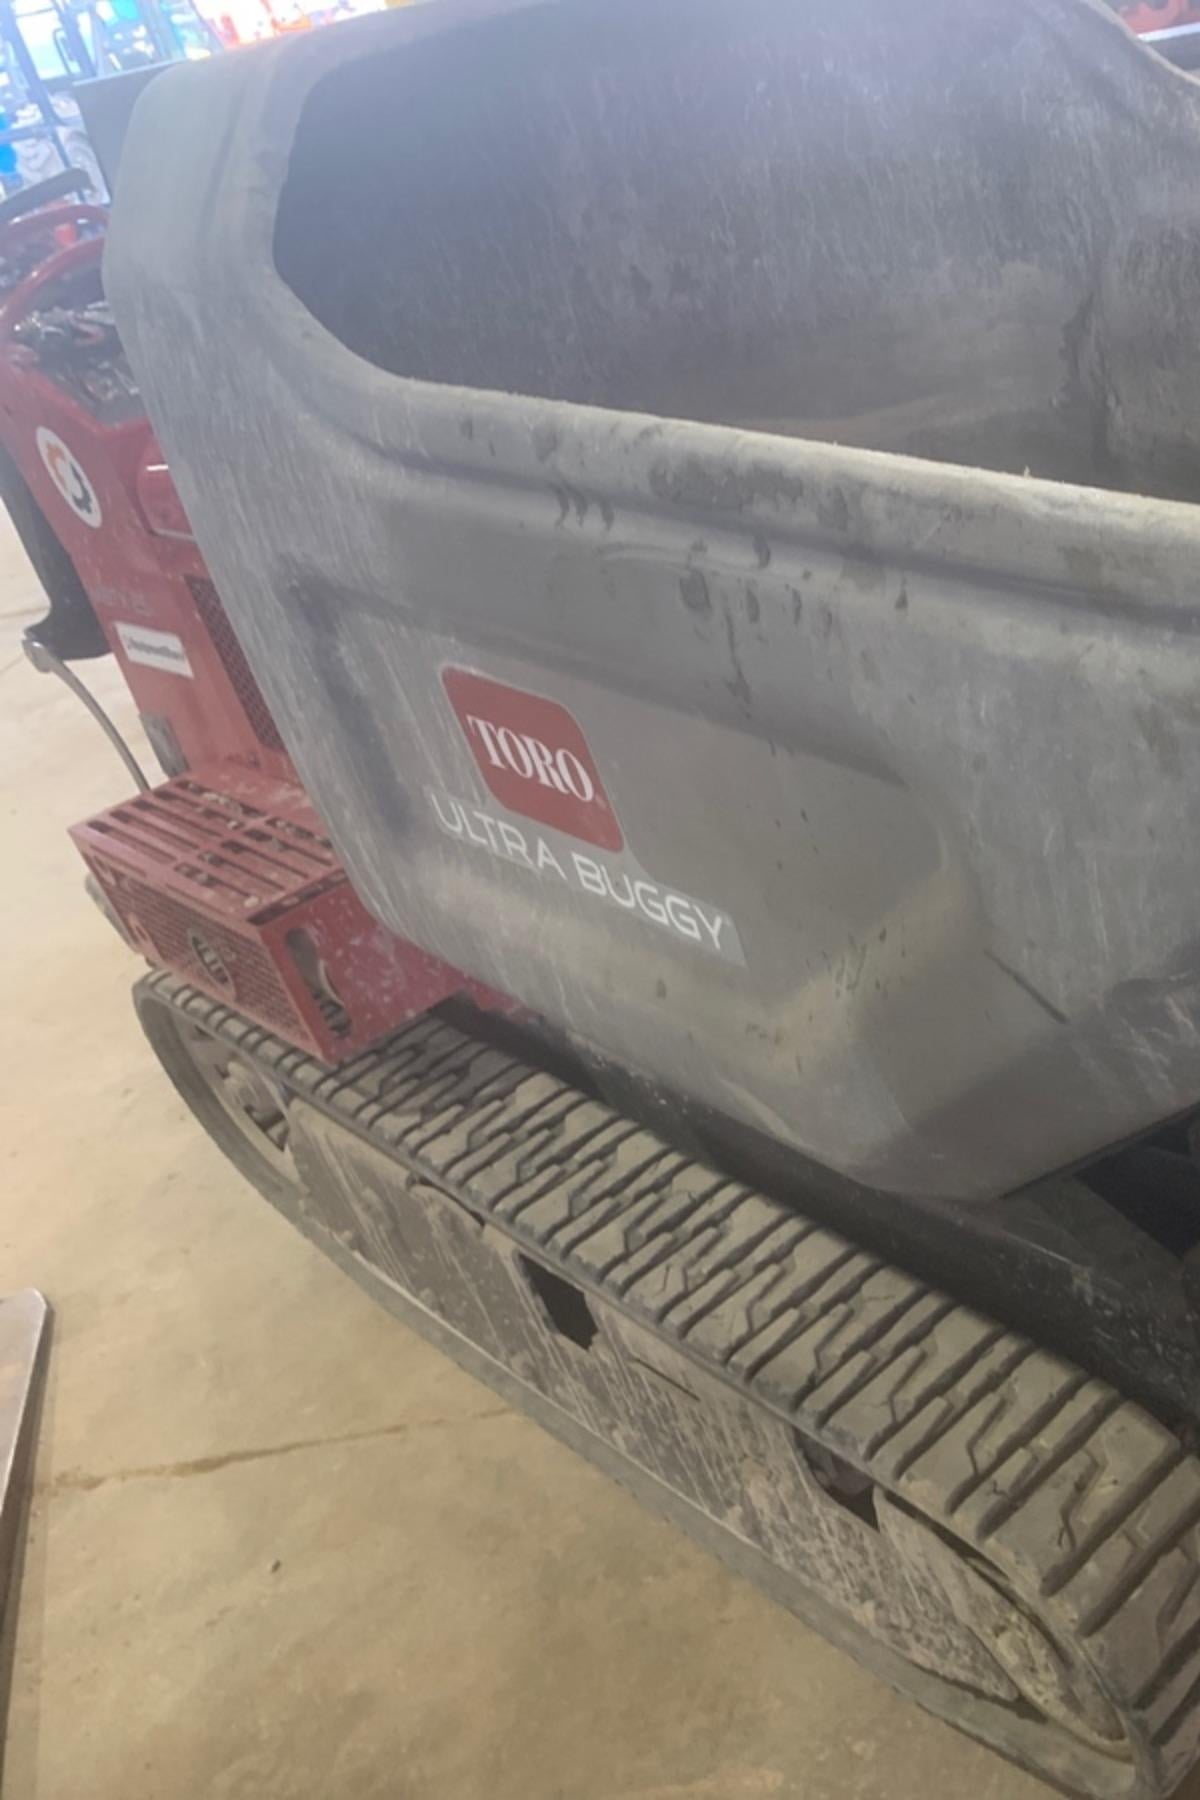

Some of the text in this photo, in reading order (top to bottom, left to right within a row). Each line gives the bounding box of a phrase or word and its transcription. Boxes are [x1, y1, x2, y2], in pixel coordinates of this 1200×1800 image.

[466, 714, 596, 803] TORO
[431, 794, 722, 950] ULTRA BUGGY
